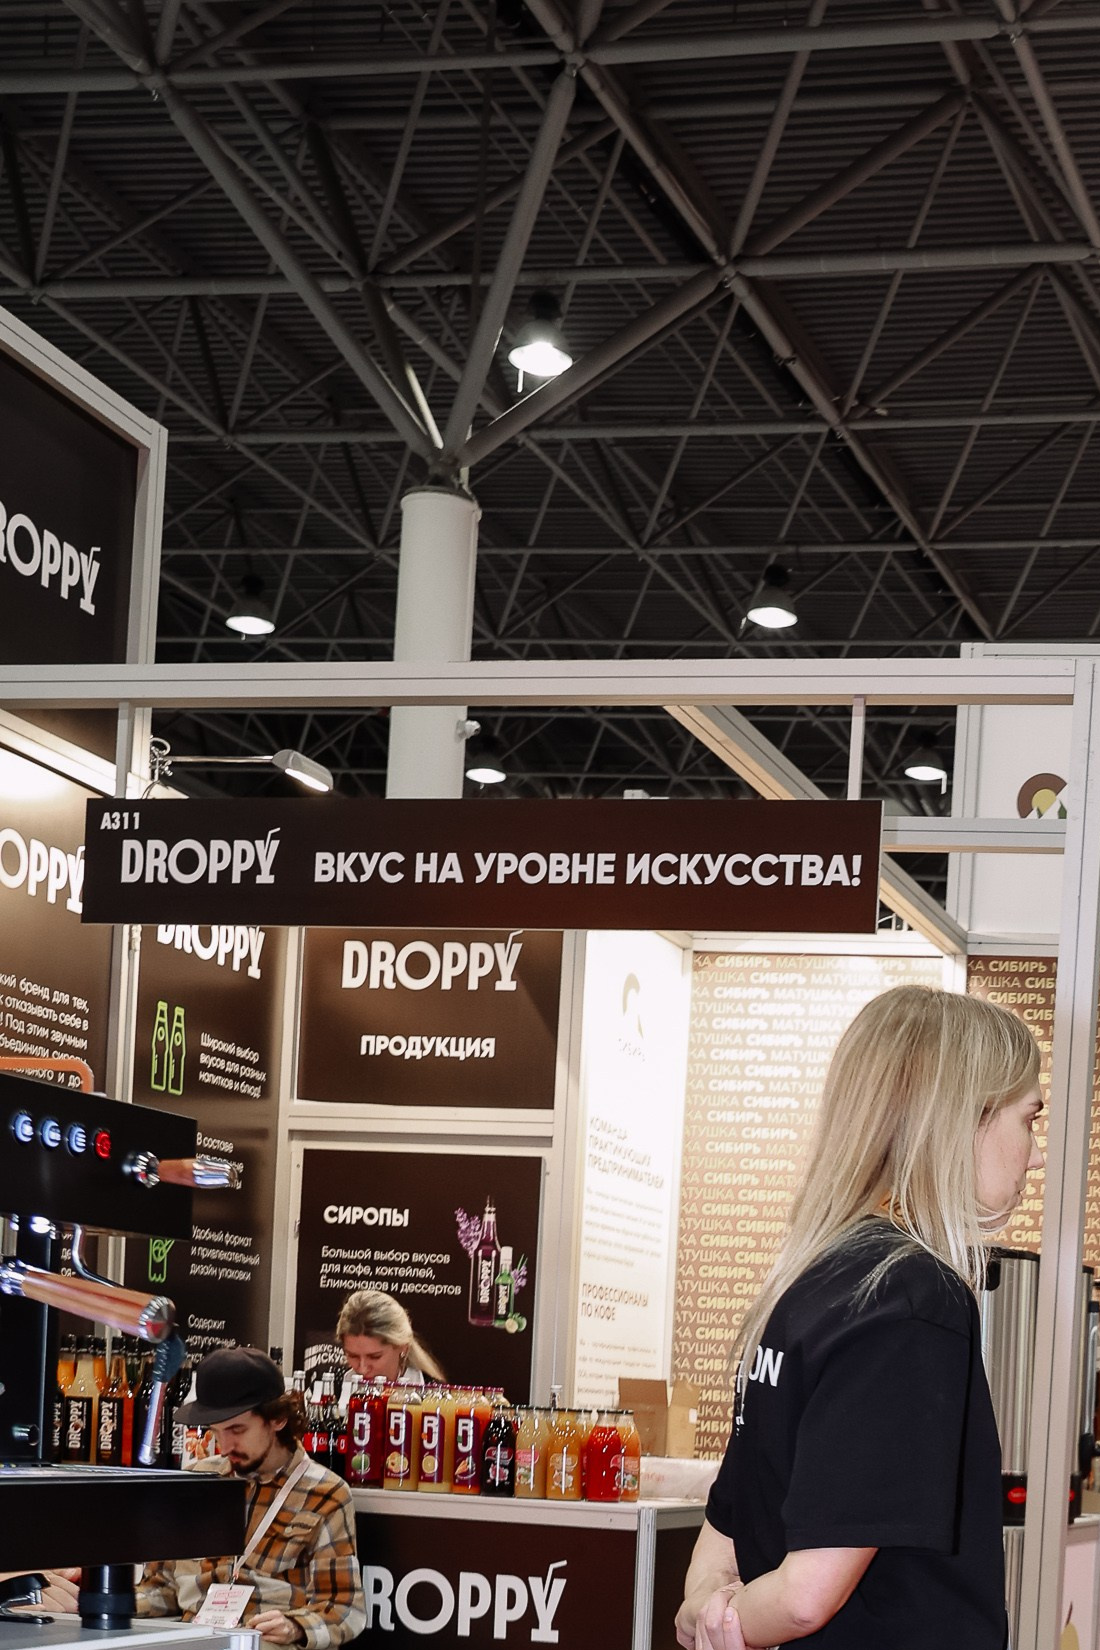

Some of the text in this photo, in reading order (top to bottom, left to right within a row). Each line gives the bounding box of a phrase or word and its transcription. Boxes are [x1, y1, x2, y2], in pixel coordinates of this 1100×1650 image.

[121, 828, 280, 884] DROPPY
[315, 851, 862, 887] ВКУС НА УРОВНЕ ИСКУССТВА!
[341, 930, 523, 992] DROPPY
[715, 956, 843, 971] СИБИРЬ МАТУШКА
[989, 960, 1047, 973] СИБИРЬ
[749, 972, 806, 985] СИБИРЬ
[811, 974, 880, 987] МАТУШКА
[20, 978, 50, 1001] бренд
[52, 990, 70, 1005] для
[72, 996, 90, 1014] тех,
[714, 987, 769, 1000] СИБИРЬ
[987, 992, 1046, 1005] СИБИРЬ
[5, 995, 89, 1031] отказывать себе в
[748, 1003, 805, 1016] СИБИРЬ
[5, 1013, 88, 1050] Под этим звучным
[712, 1017, 842, 1033] СИБИРЬ МАТУШКА
[200, 1032, 259, 1064] Широкий выбор
[360, 1034, 496, 1061] ПРОДУКЦИЯ
[746, 1034, 803, 1047] СИБИРЬ
[710, 1048, 766, 1061] СИБИРЬ
[200, 1053, 225, 1070] вкусов
[225, 1061, 239, 1073] для
[745, 1065, 801, 1078] СИБИРЬ
[199, 1071, 233, 1091] напитков
[234, 1079, 240, 1091] и
[709, 1079, 764, 1092] СИБИРЬ
[743, 1096, 799, 1109] СИБИРЬ
[707, 1110, 762, 1123] СИБИРЬ
[741, 1127, 798, 1140] СИБИРЬ
[203, 1136, 233, 1153] составе
[705, 1141, 761, 1155] СИБИРЬ
[739, 1158, 796, 1171] СИБИРЬ
[703, 1172, 760, 1186] СИБИРЬ
[738, 1189, 795, 1202] СИБИРЬ
[323, 1205, 409, 1227] СИРОПЫ
[702, 1203, 759, 1217] СИБИРЬ
[192, 1225, 252, 1247] Удобный формат
[700, 1234, 757, 1248] СИБИРЬ
[191, 1246, 260, 1266] и привлекательный
[321, 1246, 450, 1265] Большой выбор вкусов
[190, 1263, 251, 1281] дизайн упаковки
[320, 1263, 436, 1280] для кофе, коктейлей,
[699, 1265, 755, 1279] СИБИРЬ
[391, 1283, 398, 1291] и
[400, 1282, 461, 1296] дессертов
[582, 1283, 649, 1307] ПРОФЕССИОНАЛЫ
[697, 1296, 752, 1310] СИБИРЬ
[581, 1302, 616, 1321] ПО КОФЕ
[188, 1314, 226, 1331] Содержит
[68, 1400, 83, 1448] DROPPY
[100, 1400, 114, 1450] DROPPY
[362, 1560, 567, 1643] ROPPY
